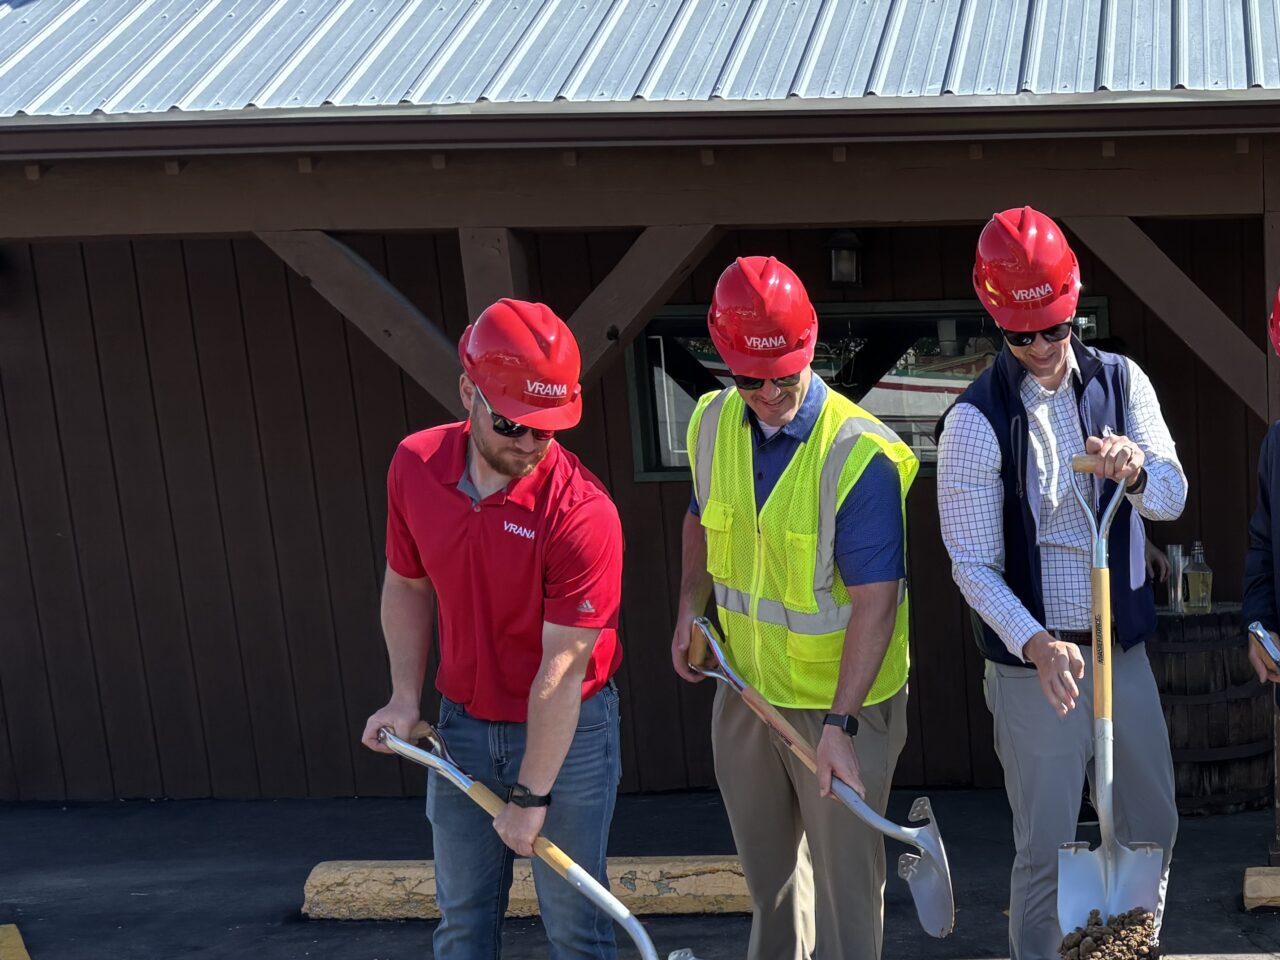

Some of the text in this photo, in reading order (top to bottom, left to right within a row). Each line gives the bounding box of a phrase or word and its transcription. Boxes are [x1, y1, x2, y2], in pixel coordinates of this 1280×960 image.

[1011, 282, 1053, 301] VRANA
[744, 335, 787, 349] VRANA
[526, 379, 567, 396] VRANA
[503, 520, 536, 540] VRANA
